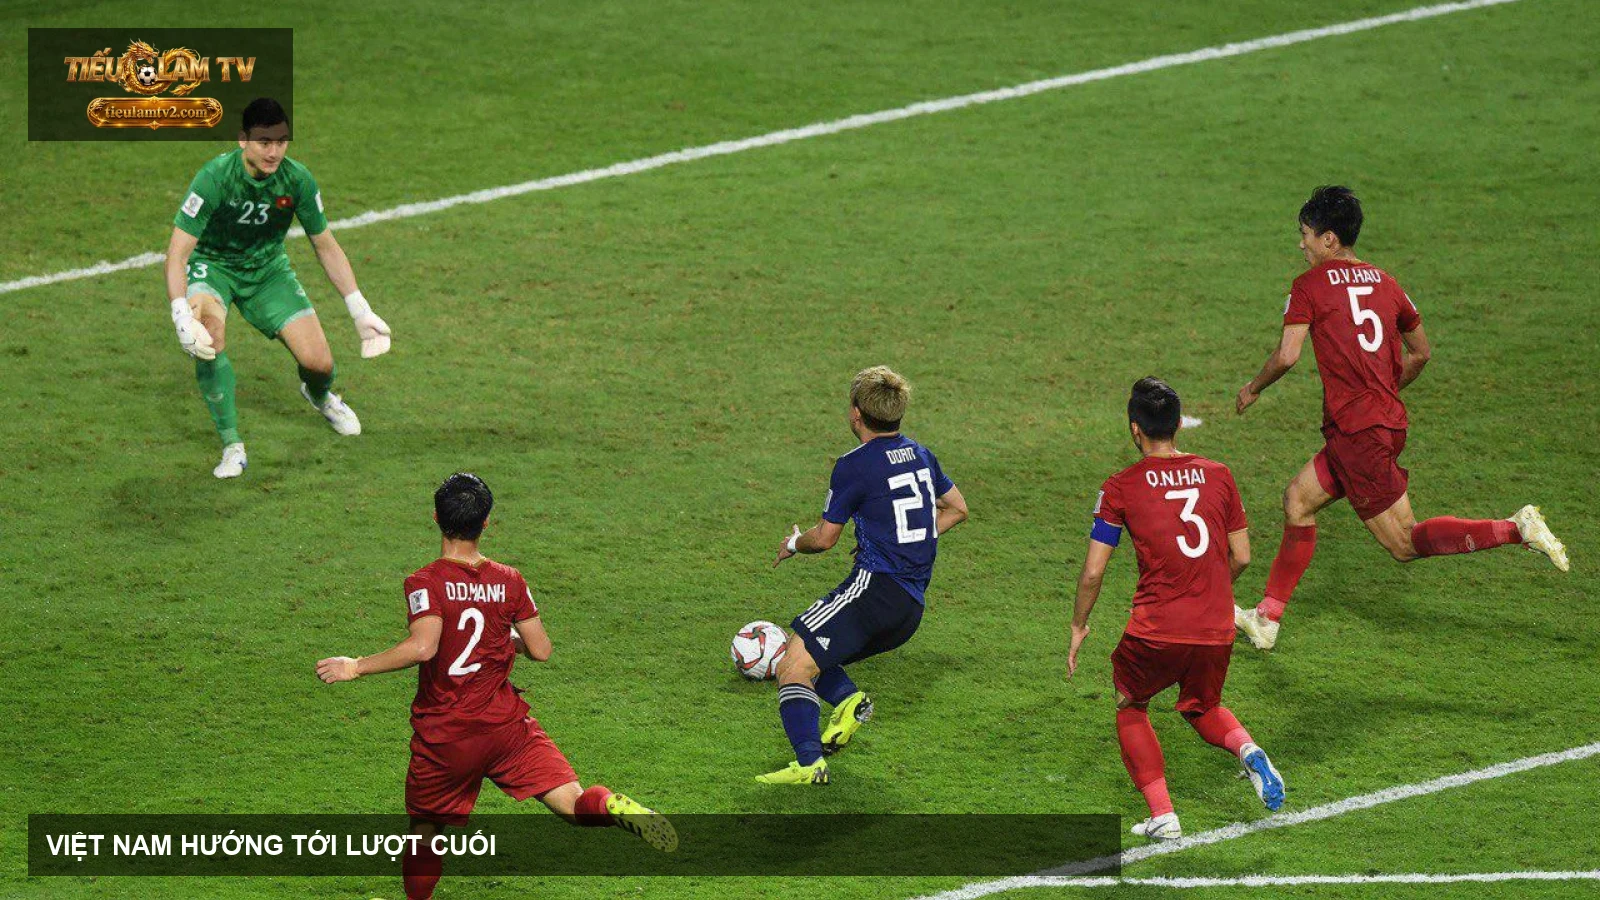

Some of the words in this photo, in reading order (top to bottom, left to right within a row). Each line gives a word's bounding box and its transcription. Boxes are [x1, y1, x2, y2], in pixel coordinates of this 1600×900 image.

[238, 201, 270, 225] 23
[1327, 268, 1381, 285] D.V.HAU
[1347, 286, 1383, 353] 5
[887, 468, 938, 544] 21
[1145, 468, 1206, 488] Q.N.HAI
[1164, 488, 1210, 558] 3
[448, 607, 485, 676] 2
